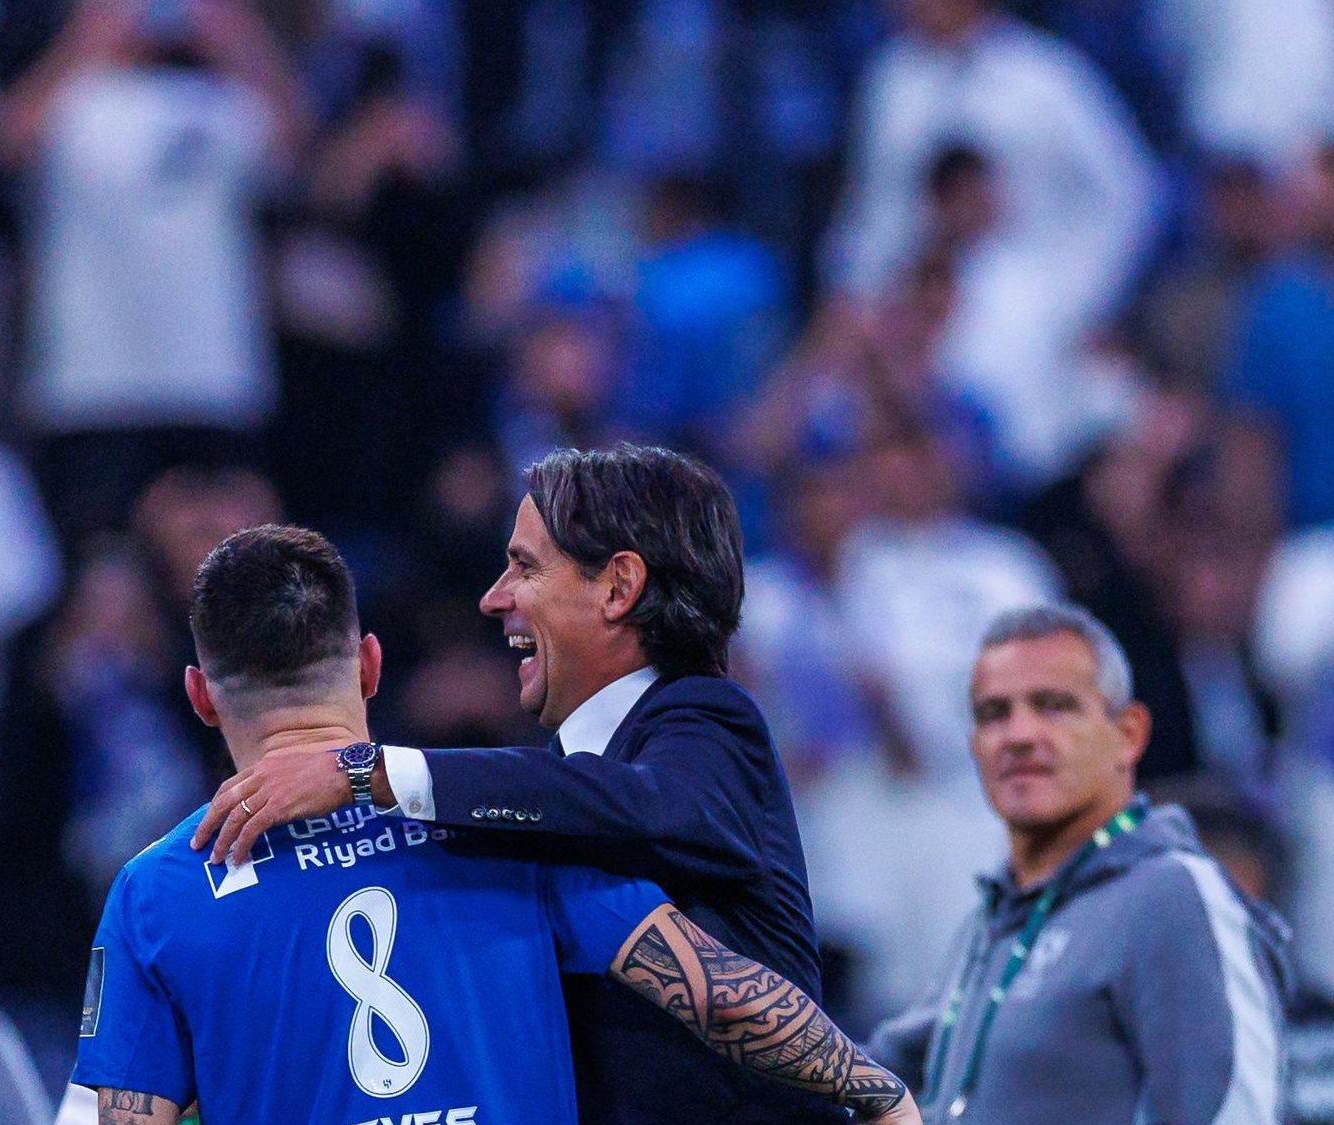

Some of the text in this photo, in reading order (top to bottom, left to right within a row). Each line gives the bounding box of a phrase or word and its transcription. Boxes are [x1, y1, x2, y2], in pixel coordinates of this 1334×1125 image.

[294, 821, 466, 871] Riyad Ba
[327, 887, 430, 1098] 8
